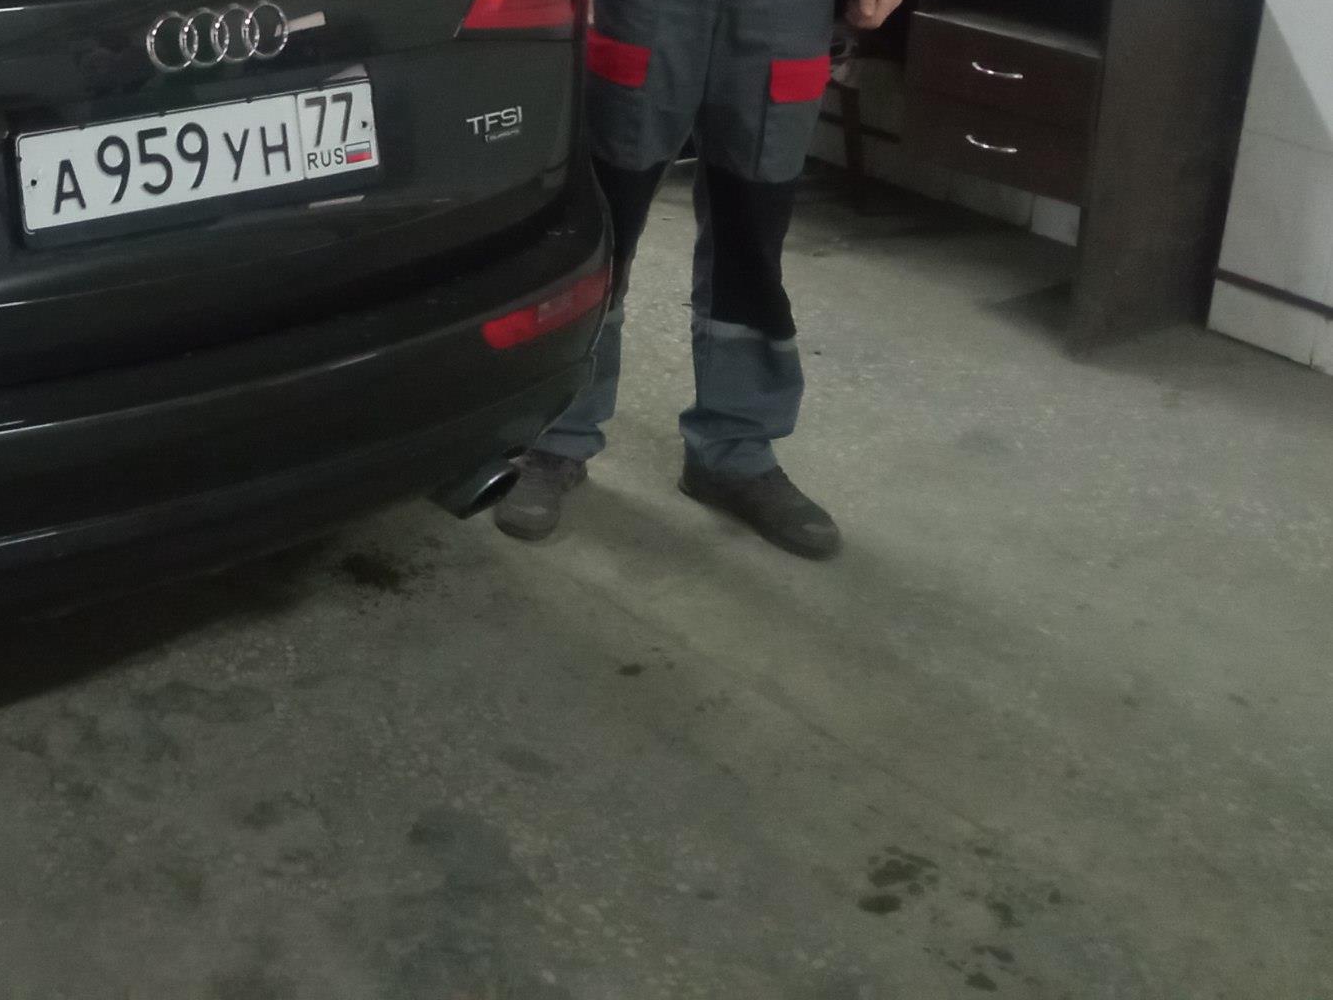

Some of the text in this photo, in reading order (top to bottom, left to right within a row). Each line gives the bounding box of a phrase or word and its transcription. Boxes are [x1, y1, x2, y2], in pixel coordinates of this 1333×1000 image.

[466, 105, 523, 135] TFSI
[52, 91, 355, 215] А959УН 77
[307, 147, 345, 171] RUS
